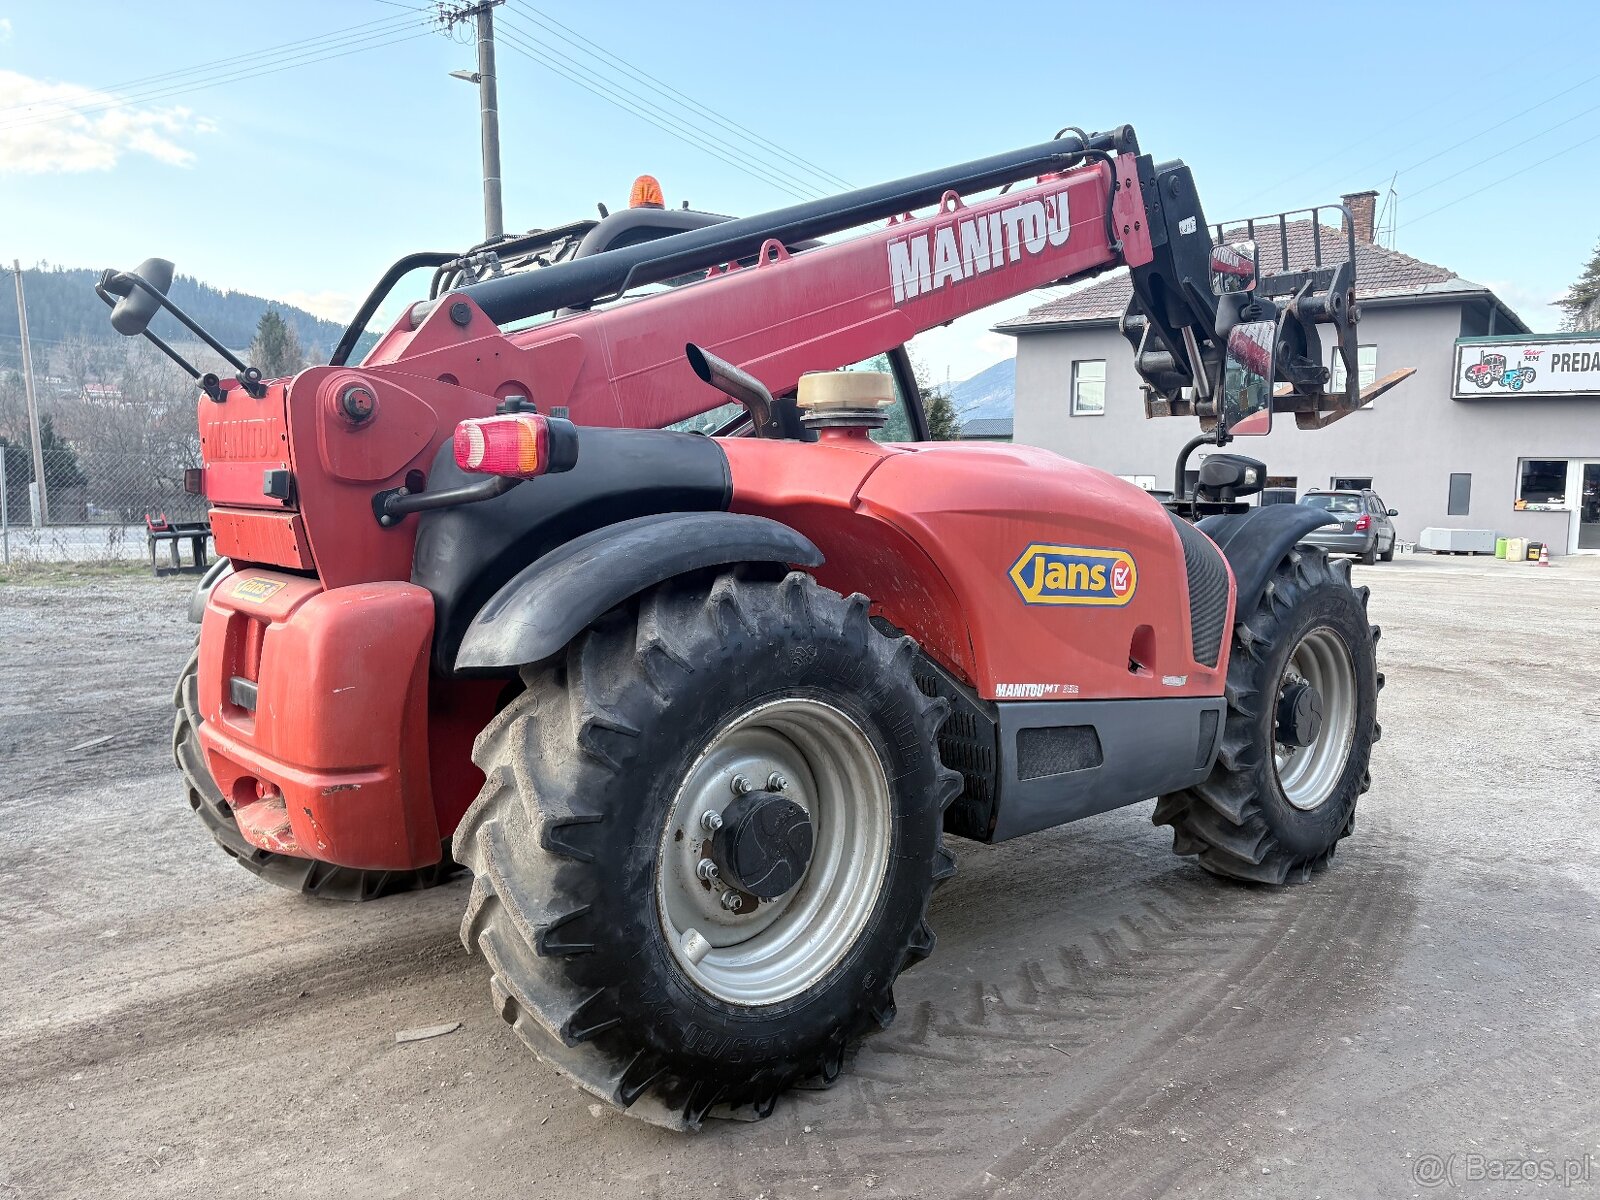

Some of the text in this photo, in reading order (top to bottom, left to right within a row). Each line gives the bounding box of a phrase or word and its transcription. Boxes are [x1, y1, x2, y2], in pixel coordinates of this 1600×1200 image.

[887, 191, 1072, 304] MANITOU
[208, 418, 279, 459] MANITOU
[1028, 557, 1106, 595] Jans
[995, 683, 1044, 697] MANITOU
[1044, 684, 1060, 693] MT
